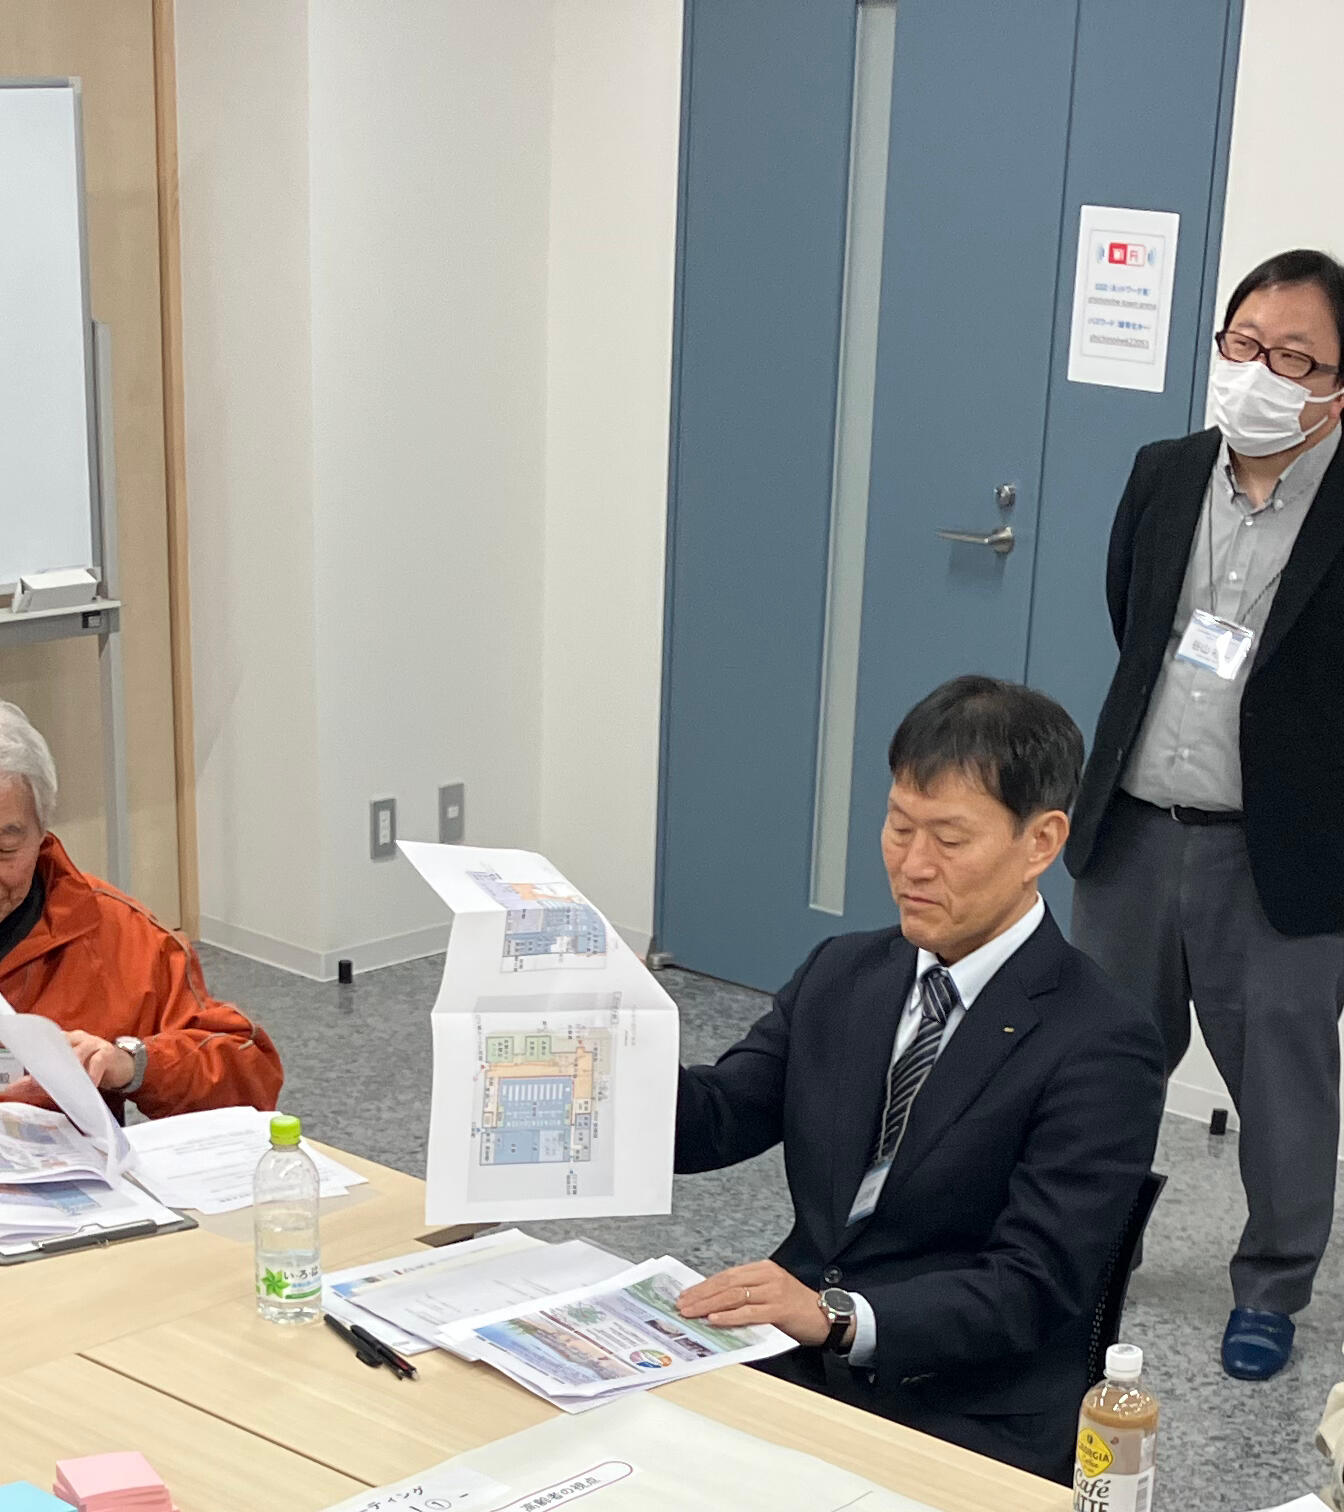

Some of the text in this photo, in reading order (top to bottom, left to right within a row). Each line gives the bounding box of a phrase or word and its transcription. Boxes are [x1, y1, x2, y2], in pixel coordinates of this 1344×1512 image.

[520, 1476, 601, 1512] 高齢者の視点
[1075, 1468, 1112, 1499] Café
